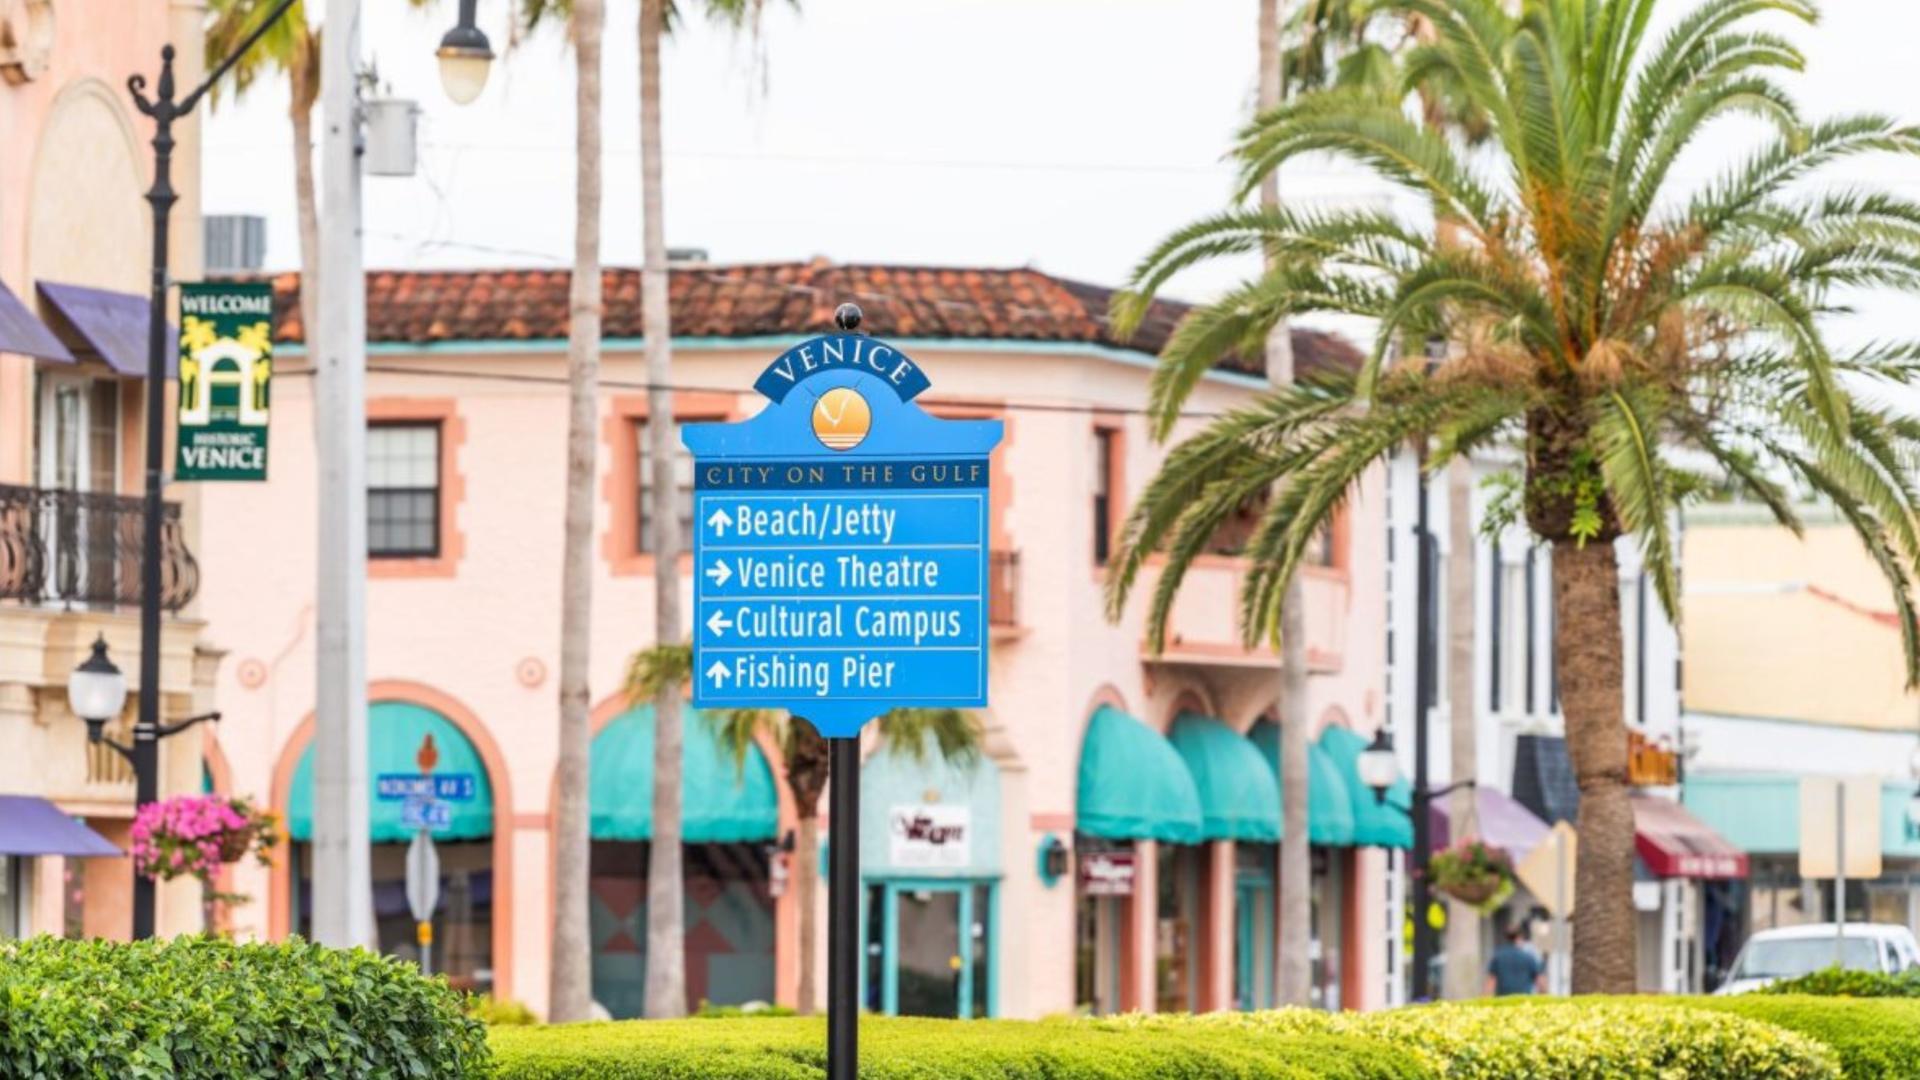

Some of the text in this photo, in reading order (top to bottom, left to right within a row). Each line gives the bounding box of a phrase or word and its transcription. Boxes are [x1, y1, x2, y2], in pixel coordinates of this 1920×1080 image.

[182, 295, 271, 314] WELCOME
[773, 338, 912, 385] VENICE
[192, 432, 256, 446] HISTORIC
[182, 446, 265, 469] VENICE
[707, 465, 982, 485] CITY ON THE GULF
[737, 502, 896, 544] Beach/Jetty
[738, 554, 939, 588] Venice Theatre
[736, 604, 961, 646] Cultural Campus
[736, 654, 896, 696] Fishing Pier
